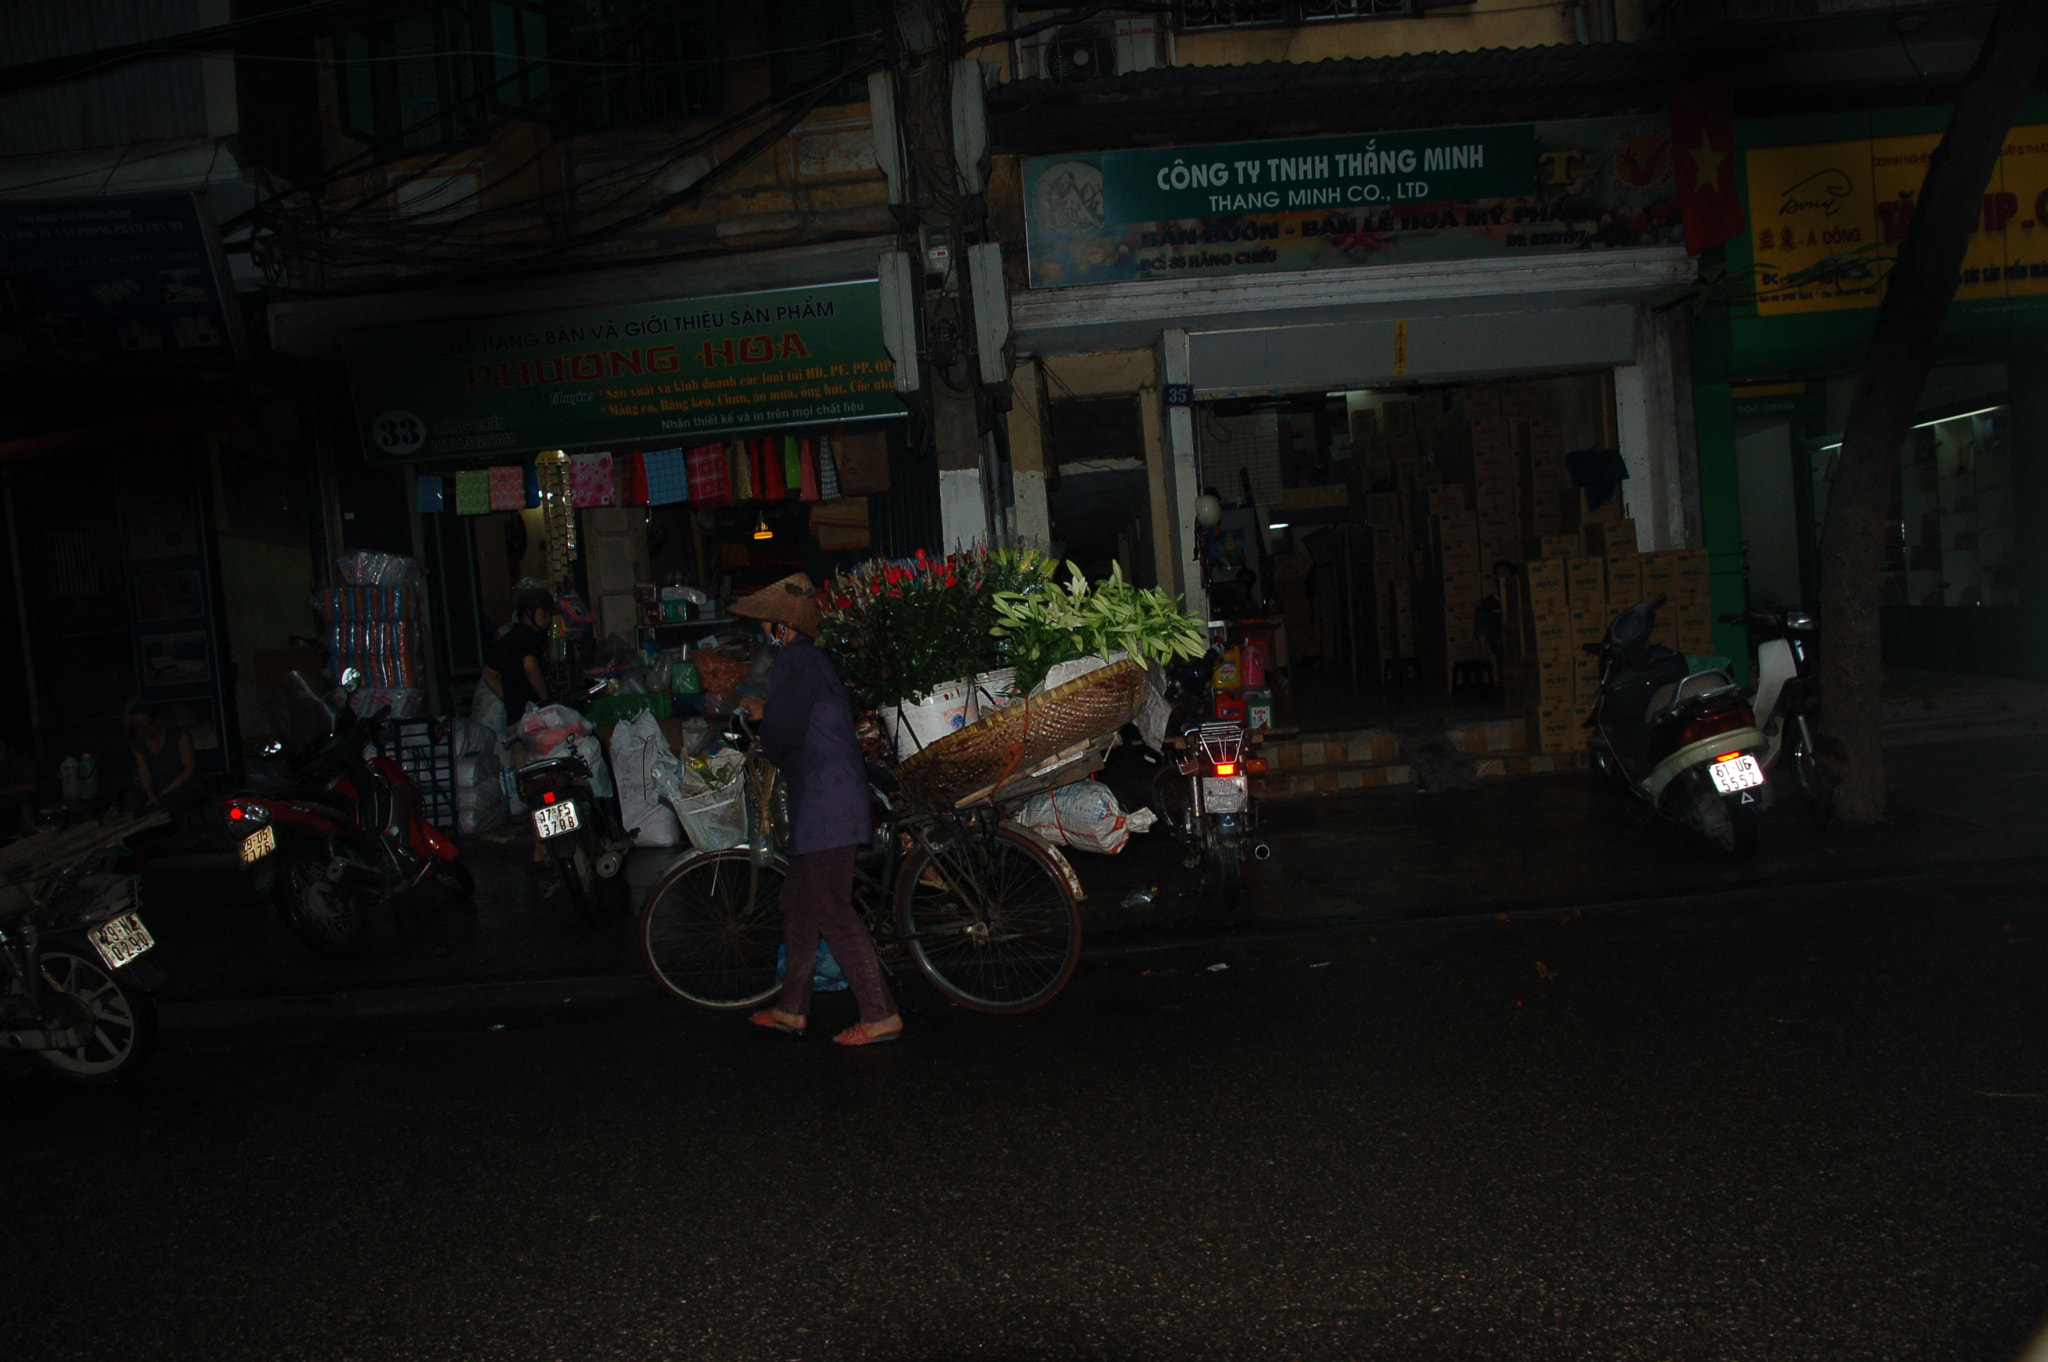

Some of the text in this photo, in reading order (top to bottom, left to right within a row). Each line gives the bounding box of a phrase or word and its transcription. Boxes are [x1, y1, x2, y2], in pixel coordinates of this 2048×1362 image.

[1157, 138, 1484, 191] CÔNG TY TNHH THẮNG MINH
[1208, 181, 1429, 212] THANG MINH CO., LTD
[481, 328, 539, 352] HÀNG
[545, 324, 584, 347] BÁN
[591, 318, 618, 341] VÀ
[624, 312, 667, 338] GIỚI
[673, 308, 724, 333] THIỆU
[730, 303, 769, 326] SẢN
[776, 295, 834, 321] PHẨM
[463, 332, 812, 393] PHƯƠNG HOA
[673, 378, 700, 393] kinh
[702, 375, 737, 391] doanh
[761, 370, 784, 386] loại
[1168, 387, 1187, 404] 35
[661, 400, 865, 432] Nhận thiết kế và in trên mọi chất liệu
[378, 419, 420, 447] 33
[543, 815, 576, 836] 3708
[111, 932, 150, 961] 0290
